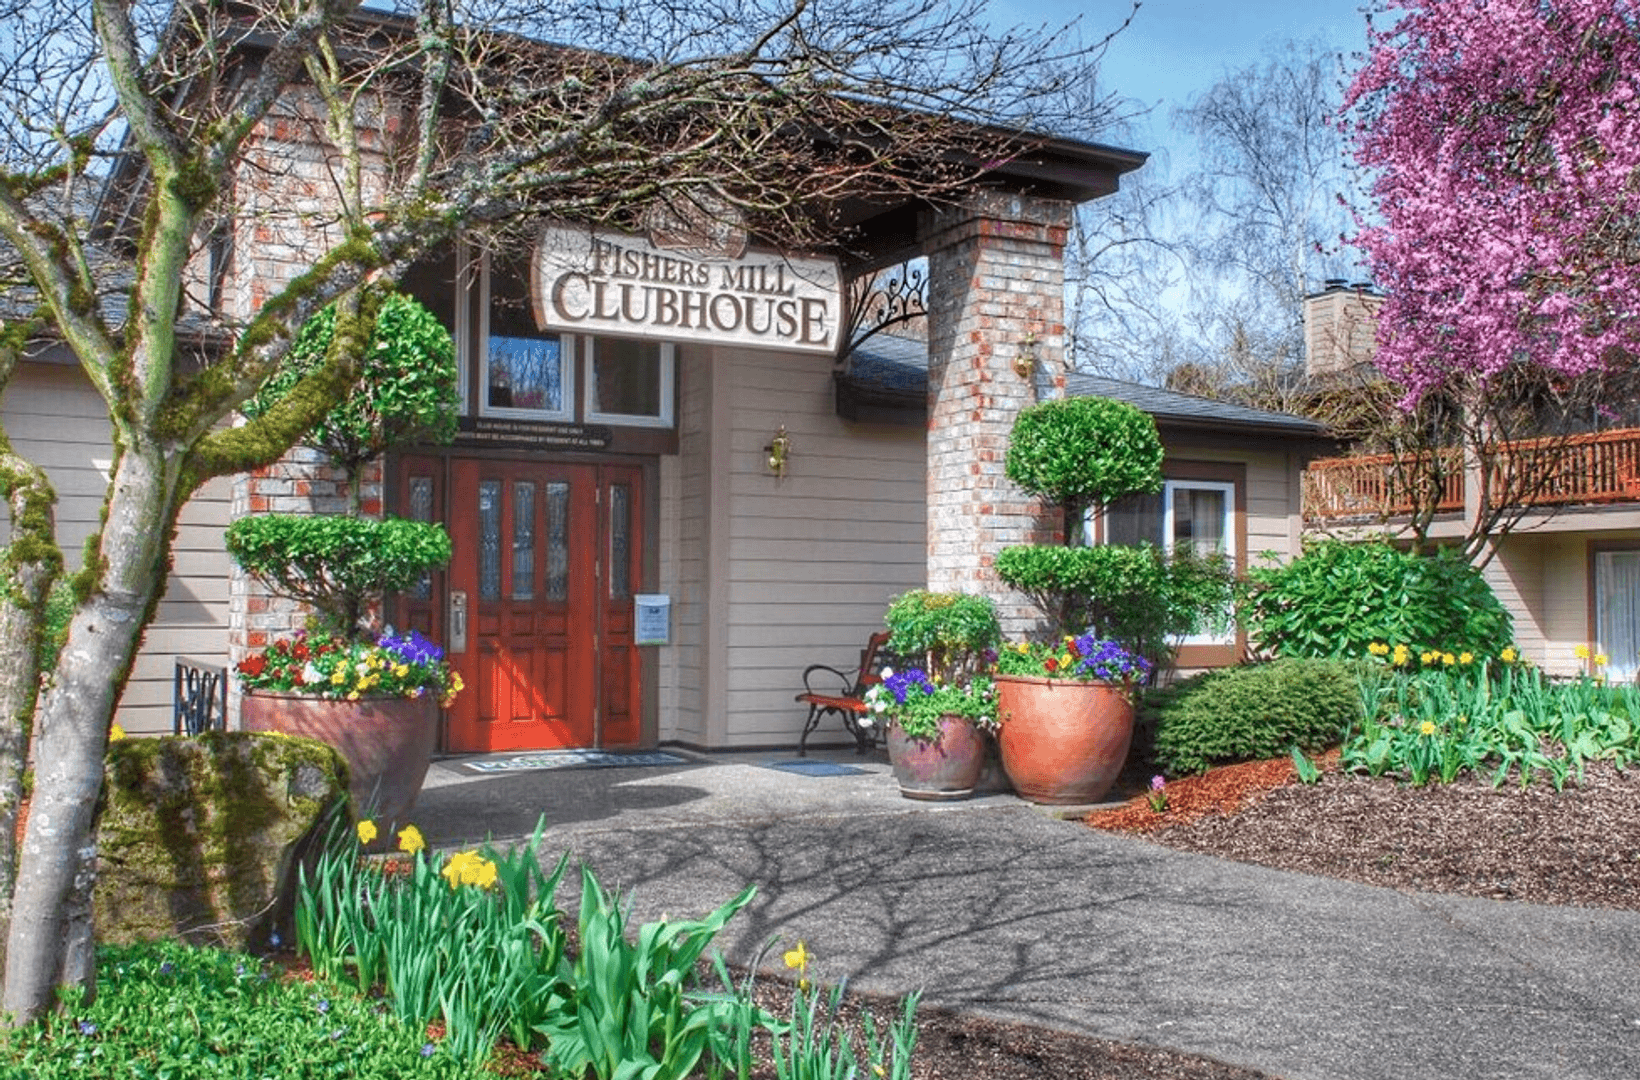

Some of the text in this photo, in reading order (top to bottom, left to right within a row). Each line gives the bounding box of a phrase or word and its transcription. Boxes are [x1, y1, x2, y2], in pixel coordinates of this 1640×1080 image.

[591, 239, 794, 297] FISHERS MILL
[551, 271, 829, 347] CLUBHOUSE
